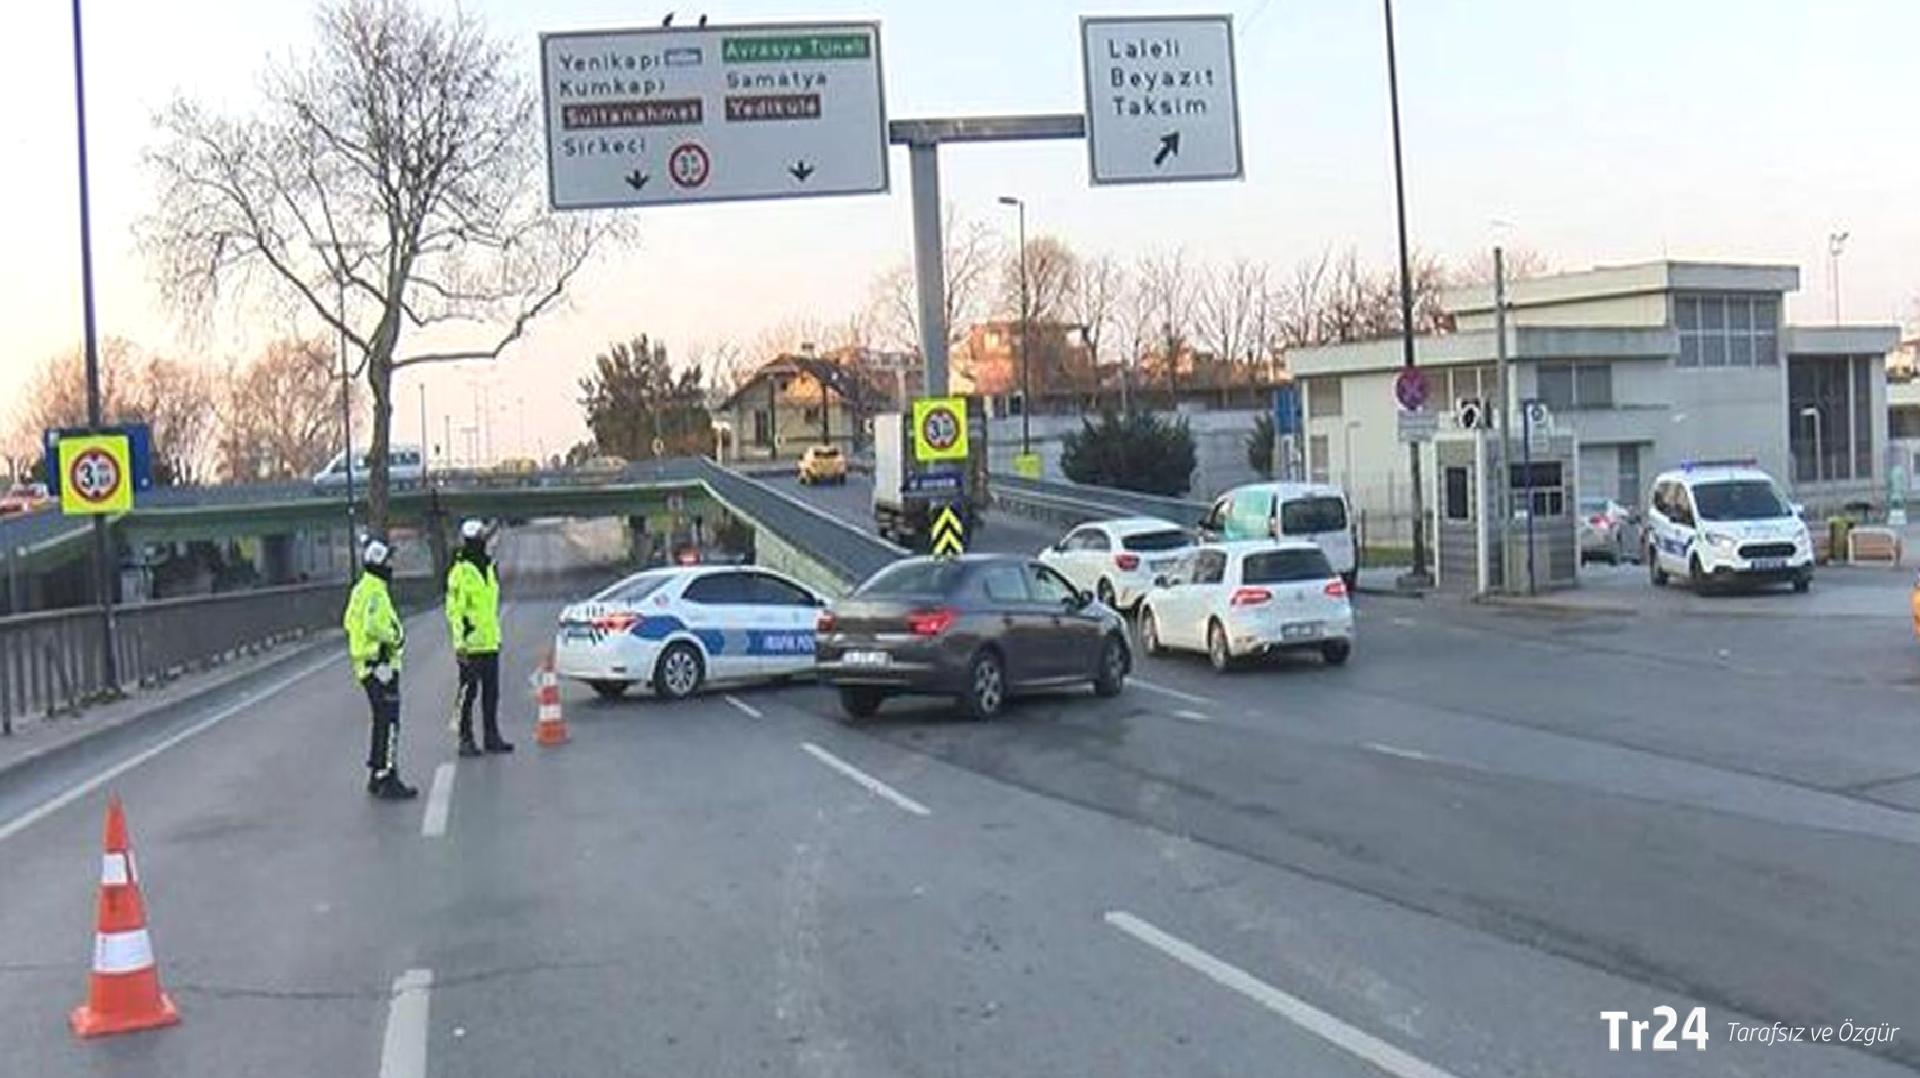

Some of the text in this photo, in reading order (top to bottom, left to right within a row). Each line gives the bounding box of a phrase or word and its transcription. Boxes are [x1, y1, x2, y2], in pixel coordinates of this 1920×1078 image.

[726, 41, 801, 61] Avrasya
[1108, 38, 1180, 58] Laleli
[558, 51, 661, 71] Yenikapı
[559, 77, 666, 96] Kumkapı
[727, 70, 827, 89] Samatya
[1110, 67, 1214, 91] Beyazıt
[566, 103, 699, 126] Sultanahmet
[731, 99, 817, 117] Yedikule
[1112, 95, 1207, 116] Taksim
[563, 136, 646, 157] Sirkeci
